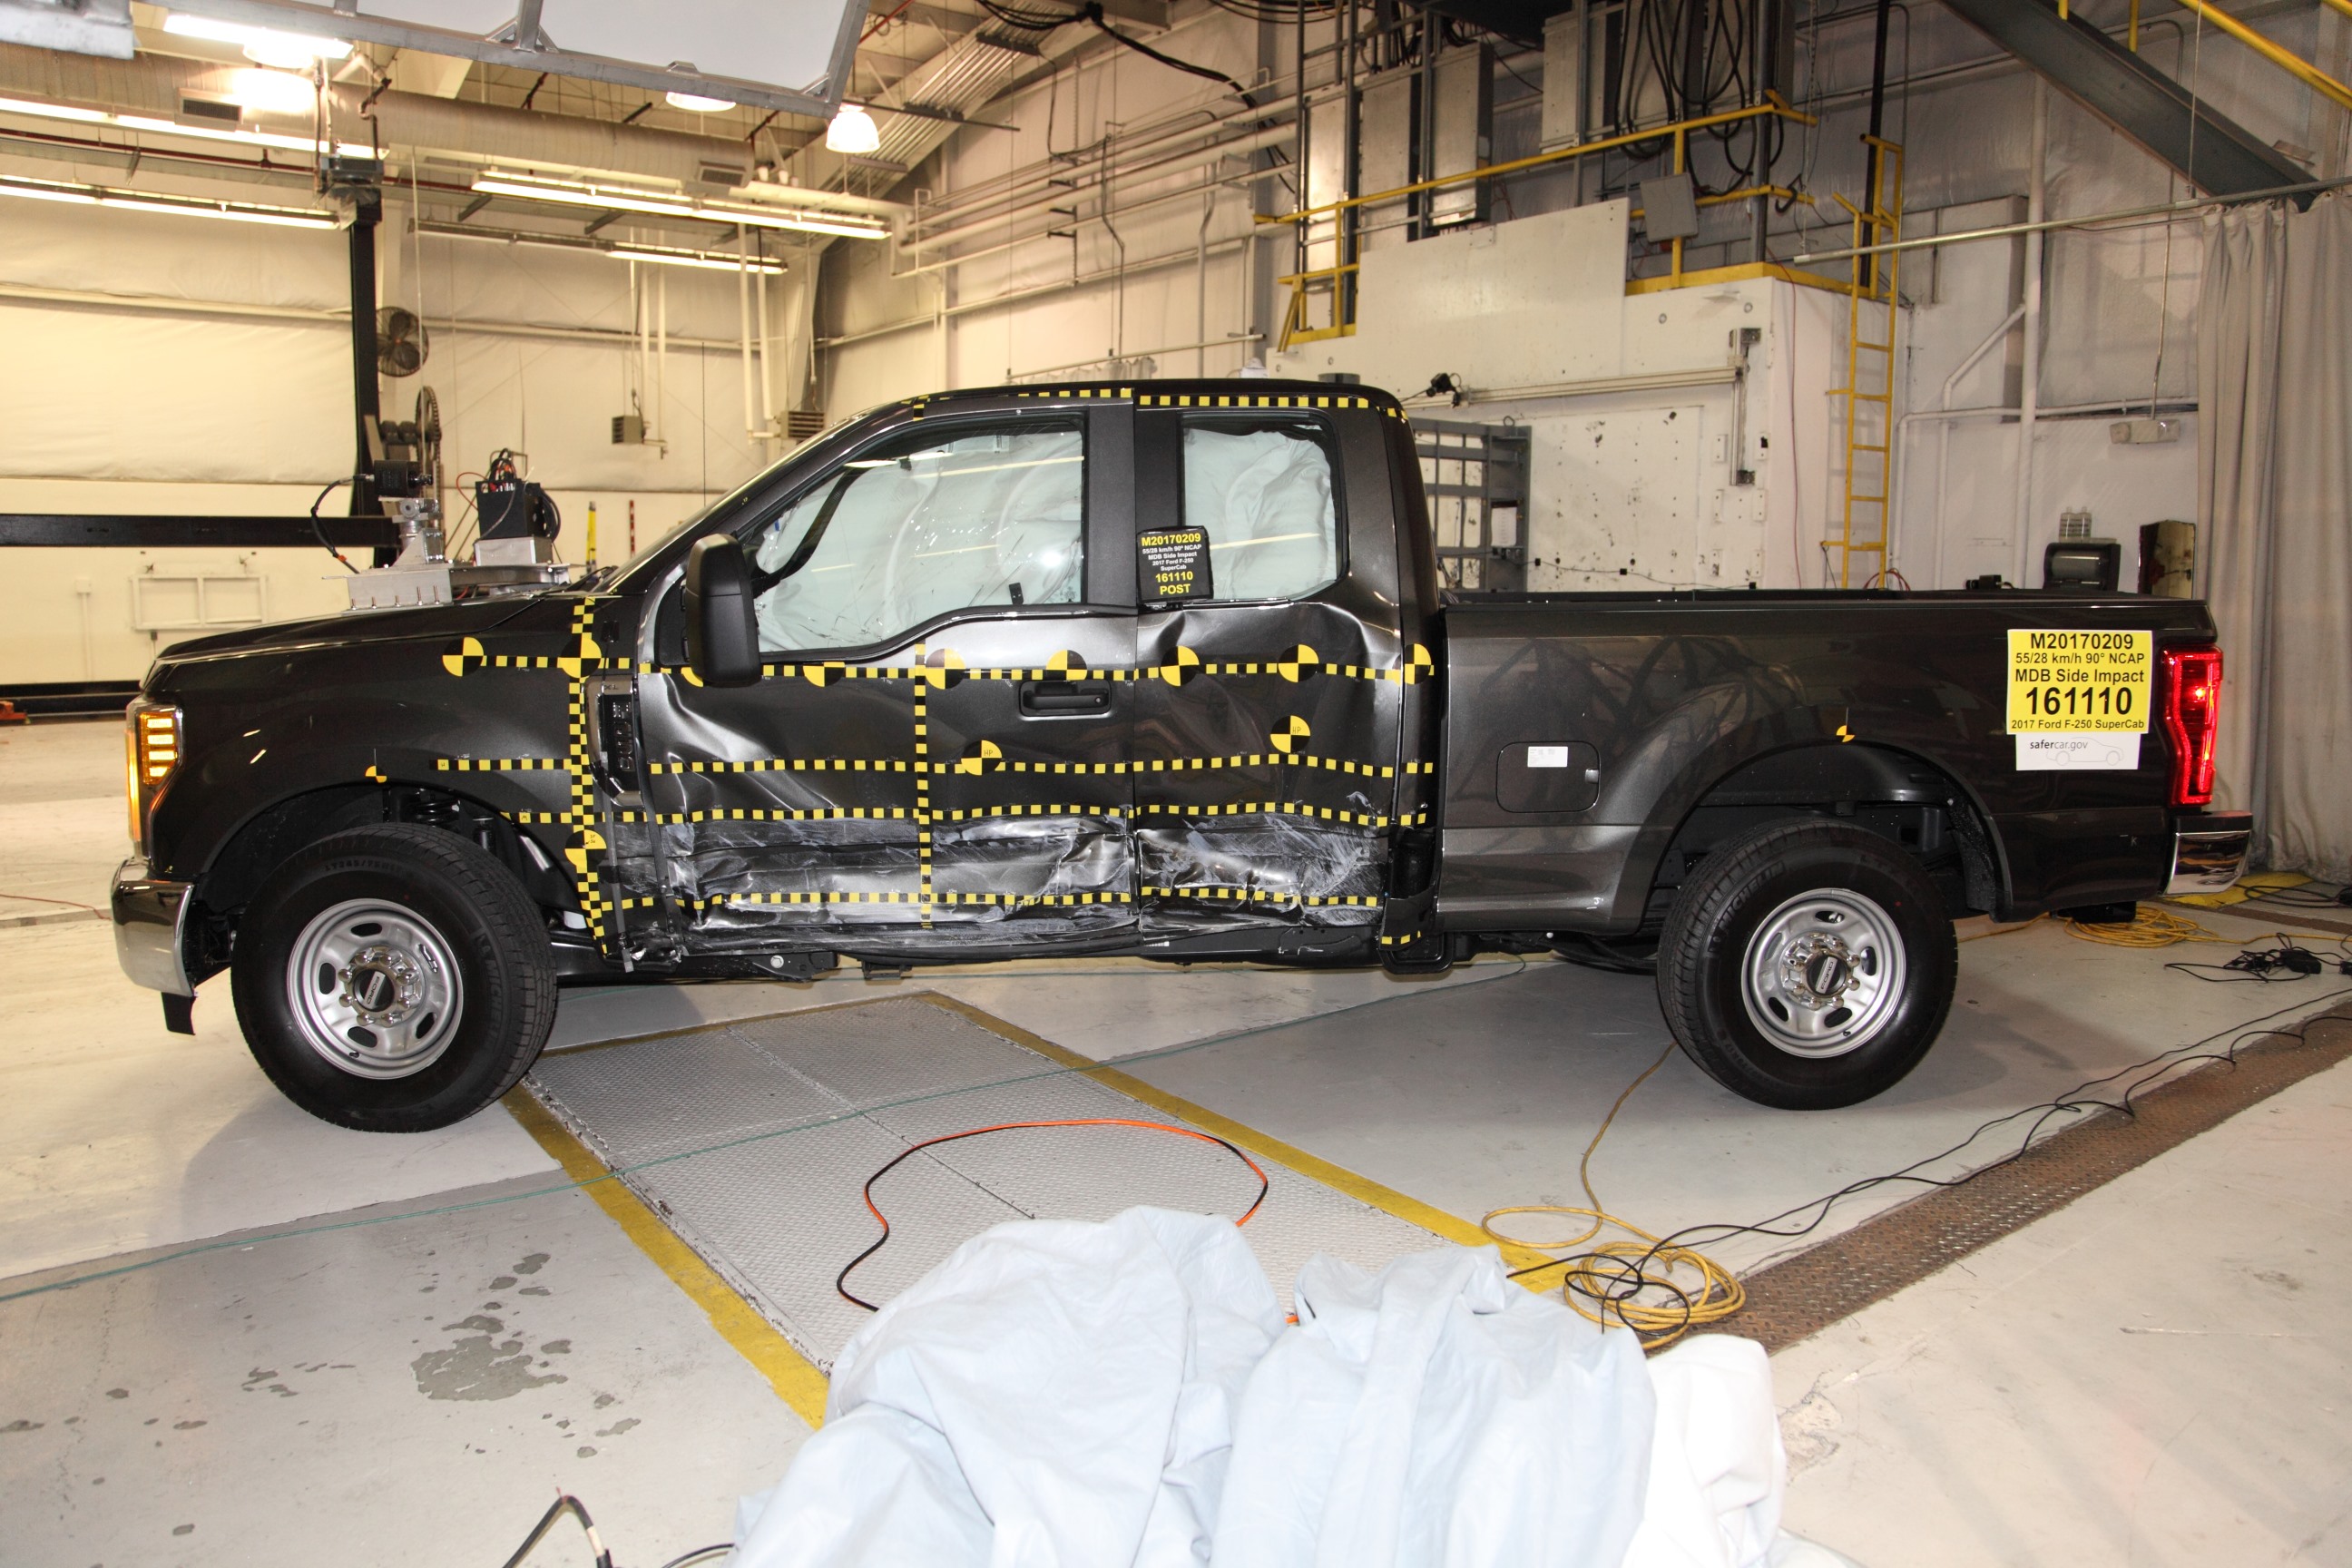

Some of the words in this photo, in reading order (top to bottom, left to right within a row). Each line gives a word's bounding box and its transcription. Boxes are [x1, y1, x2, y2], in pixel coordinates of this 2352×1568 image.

[1142, 534, 1201, 546] M20170209
[1156, 571, 1193, 583] 161110
[1160, 583, 1191, 595] POST
[2030, 633, 2133, 650] M20170209
[2016, 652, 2047, 664] 55/28
[2053, 652, 2082, 663] km/h
[2086, 652, 2104, 663] 90°
[2109, 653, 2144, 664] NCAP
[2015, 669, 2051, 682] MDB
[2056, 669, 2089, 682] Side
[2094, 670, 2144, 685] Impact
[2026, 687, 2132, 715] 161110
[2012, 720, 2034, 729] 2017
[2038, 720, 2061, 729] Ford
[2065, 720, 2092, 729] F-250
[2095, 720, 2144, 730] SuperCab
[2030, 740, 2089, 751] safercar.gov
[1821, 962, 1834, 990] FORD
[367, 976, 380, 1004] FORD
